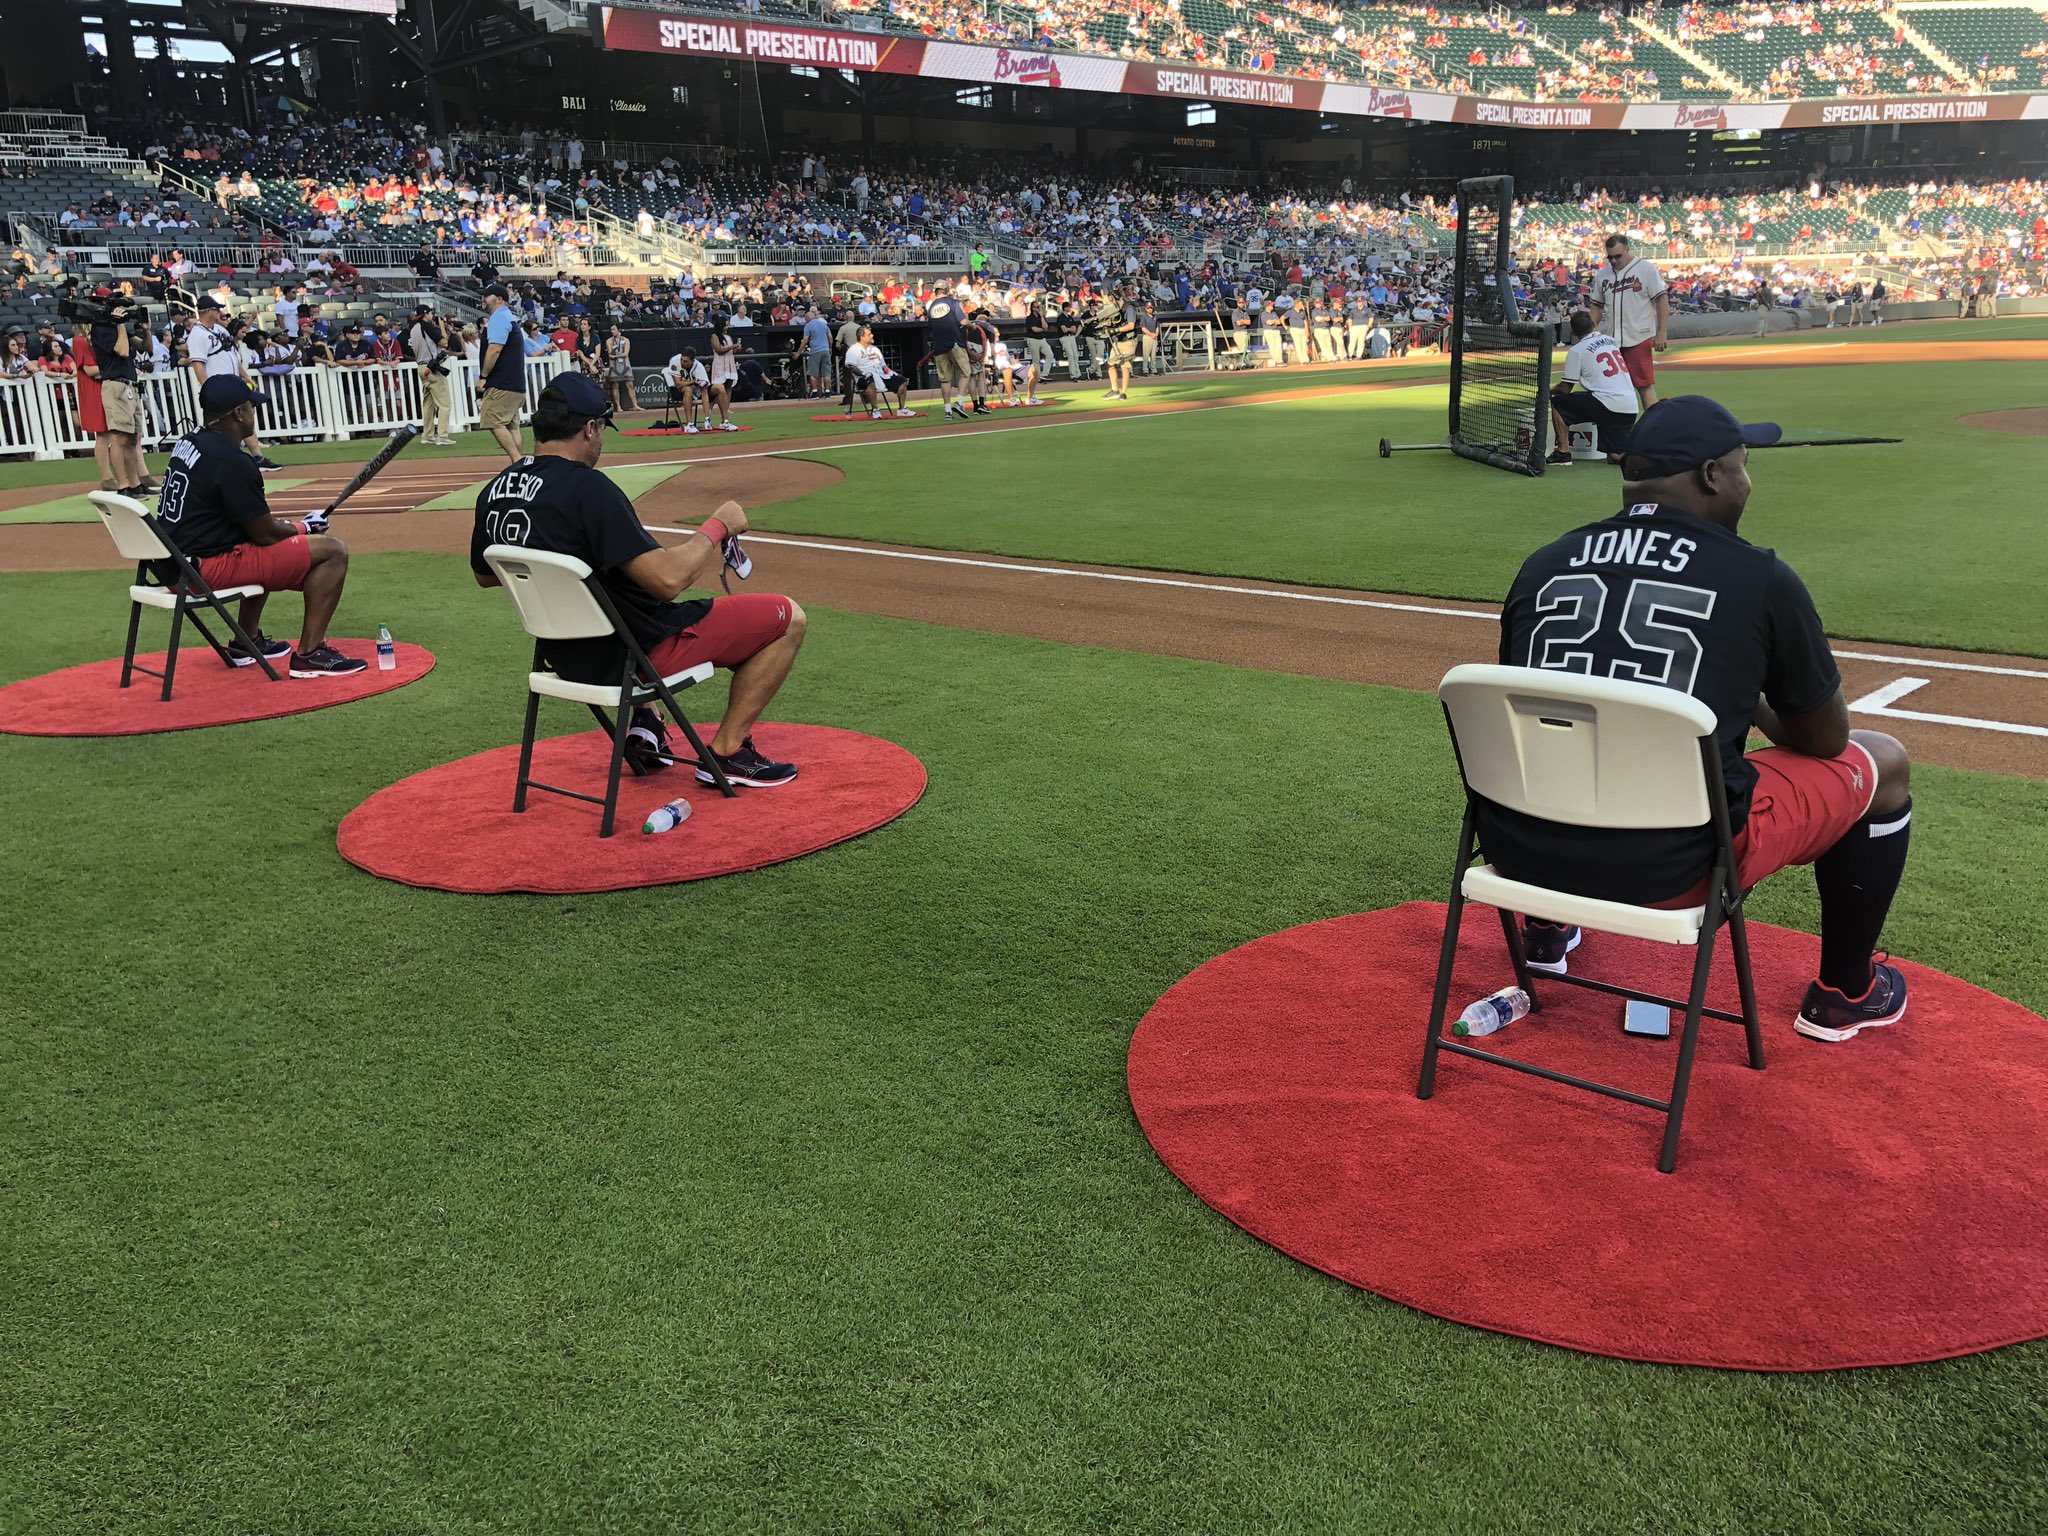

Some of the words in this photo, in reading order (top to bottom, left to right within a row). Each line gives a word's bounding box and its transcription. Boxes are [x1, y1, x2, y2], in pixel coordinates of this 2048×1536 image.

[659, 19, 742, 54] SPECIAL
[745, 29, 878, 66] PRESENTATION
[1157, 70, 1207, 96] SPECIAL
[1210, 75, 1294, 104] PRESENTATION
[614, 99, 647, 112] Classics
[1476, 102, 1511, 123] SPECIAL
[1512, 105, 1592, 126] PRESENTATION
[1822, 104, 1880, 123] SPECIAL
[1883, 101, 1988, 121] PRESENTATION
[1173, 137, 1195, 146] POTATO
[1195, 138, 1216, 148] CUTTER
[1472, 139, 1491, 150] 1871
[1569, 528, 1698, 573] JONES
[1526, 573, 1718, 698] 25
